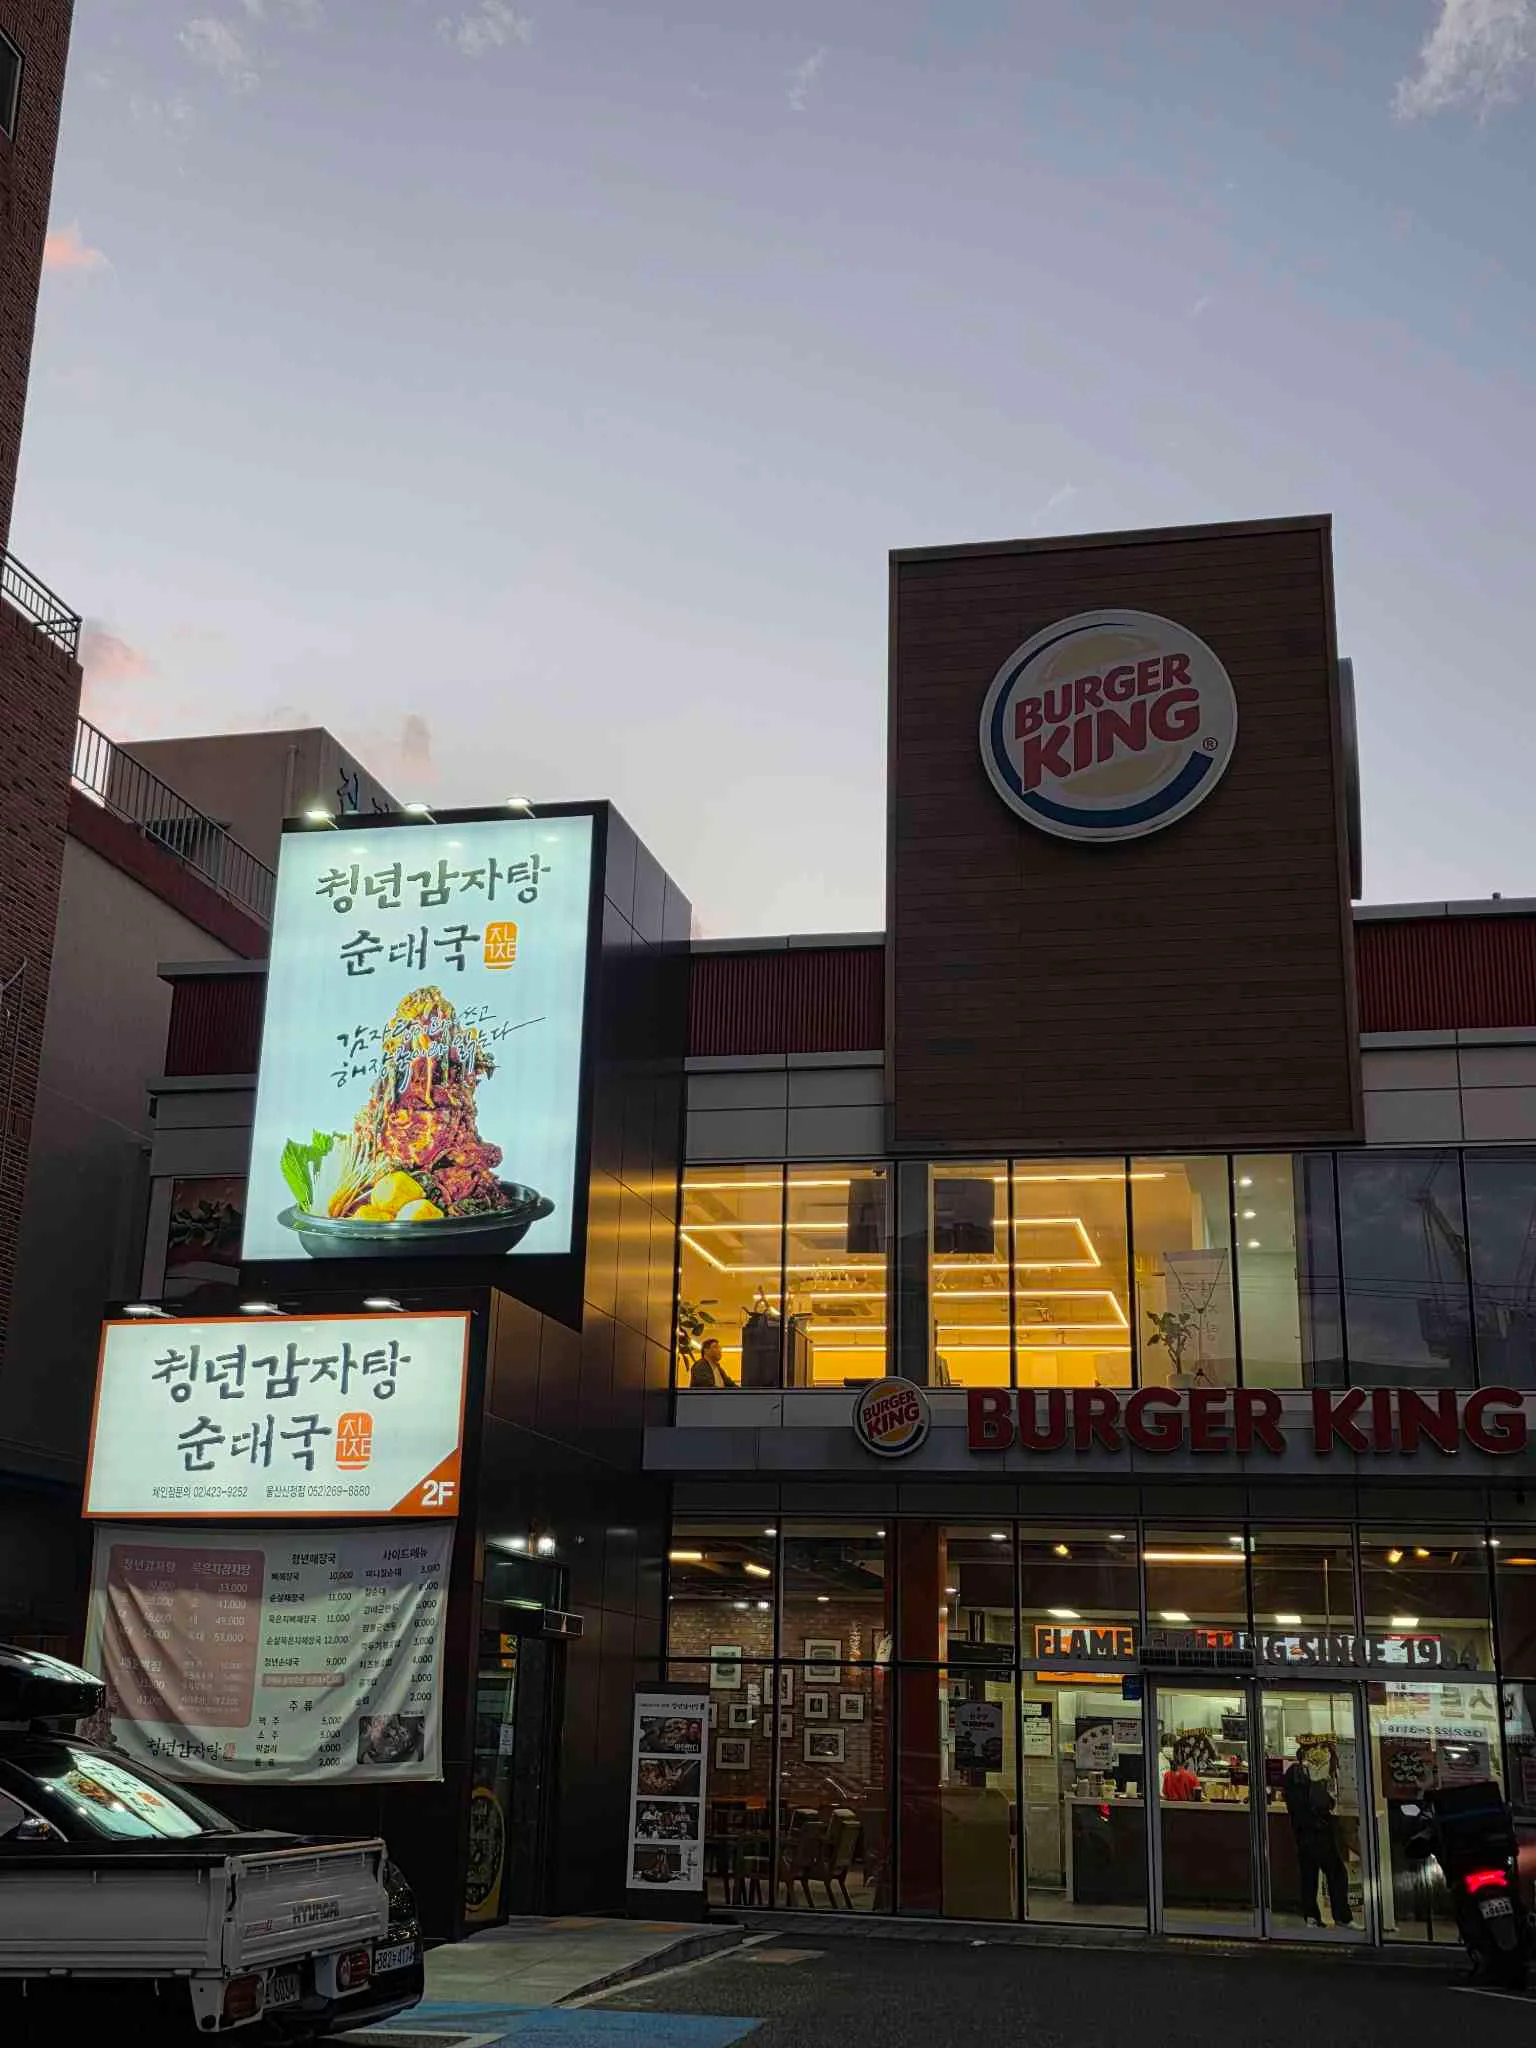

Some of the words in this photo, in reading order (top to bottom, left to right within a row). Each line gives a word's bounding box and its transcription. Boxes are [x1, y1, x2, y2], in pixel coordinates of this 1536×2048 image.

[1015, 653, 1192, 740] BURGER
[1023, 688, 1200, 792] KING
[315, 853, 551, 912] 청년감자탕
[339, 923, 480, 976] 순대국
[458, 1005, 496, 1027] 쓰고
[151, 1339, 412, 1402] 청년감자탕
[863, 1390, 914, 1422] BURGER
[866, 1402, 920, 1440] KING
[967, 1387, 1283, 1451] BURGER
[1311, 1385, 1528, 1453] KING
[177, 1413, 333, 1471] 순대국
[422, 1480, 456, 1506] 2F
[1040, 1629, 1135, 1660] FLAME
